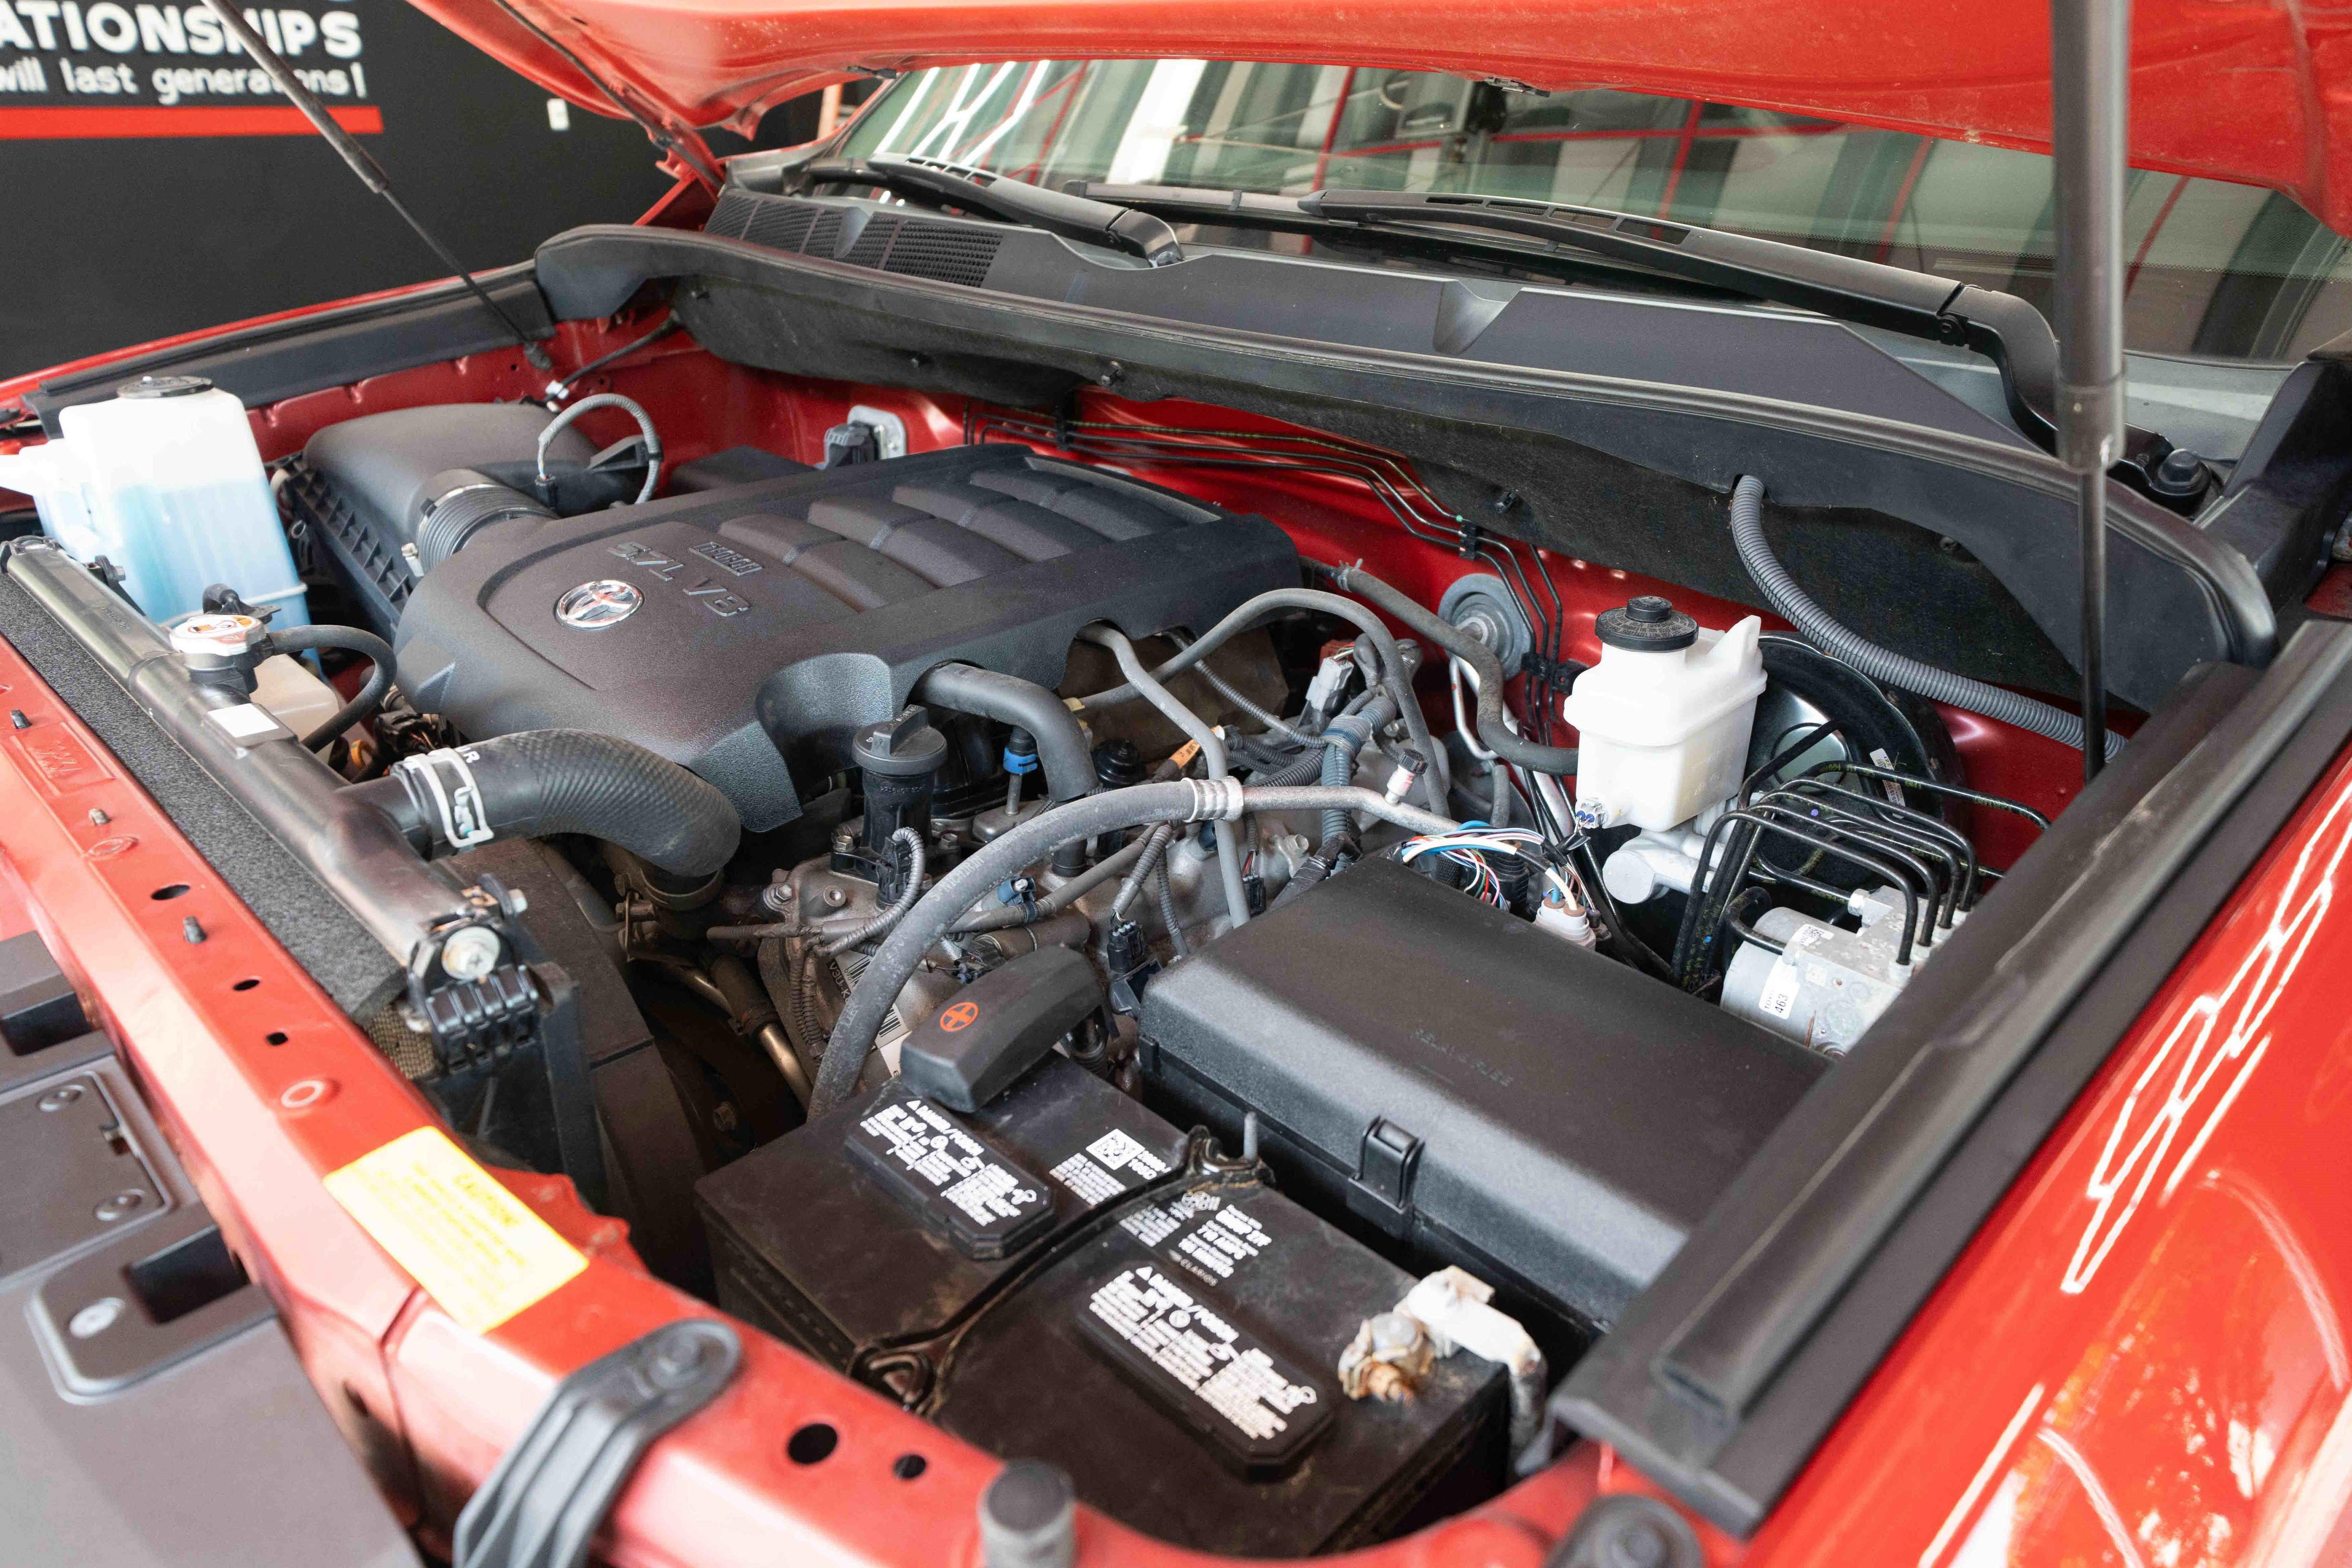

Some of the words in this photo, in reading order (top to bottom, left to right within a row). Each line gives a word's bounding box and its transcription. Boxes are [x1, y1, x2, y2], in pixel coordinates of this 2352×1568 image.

[59, 57, 139, 94] last
[151, 62, 367, 105] generans!
[683, 578, 751, 617] V8
